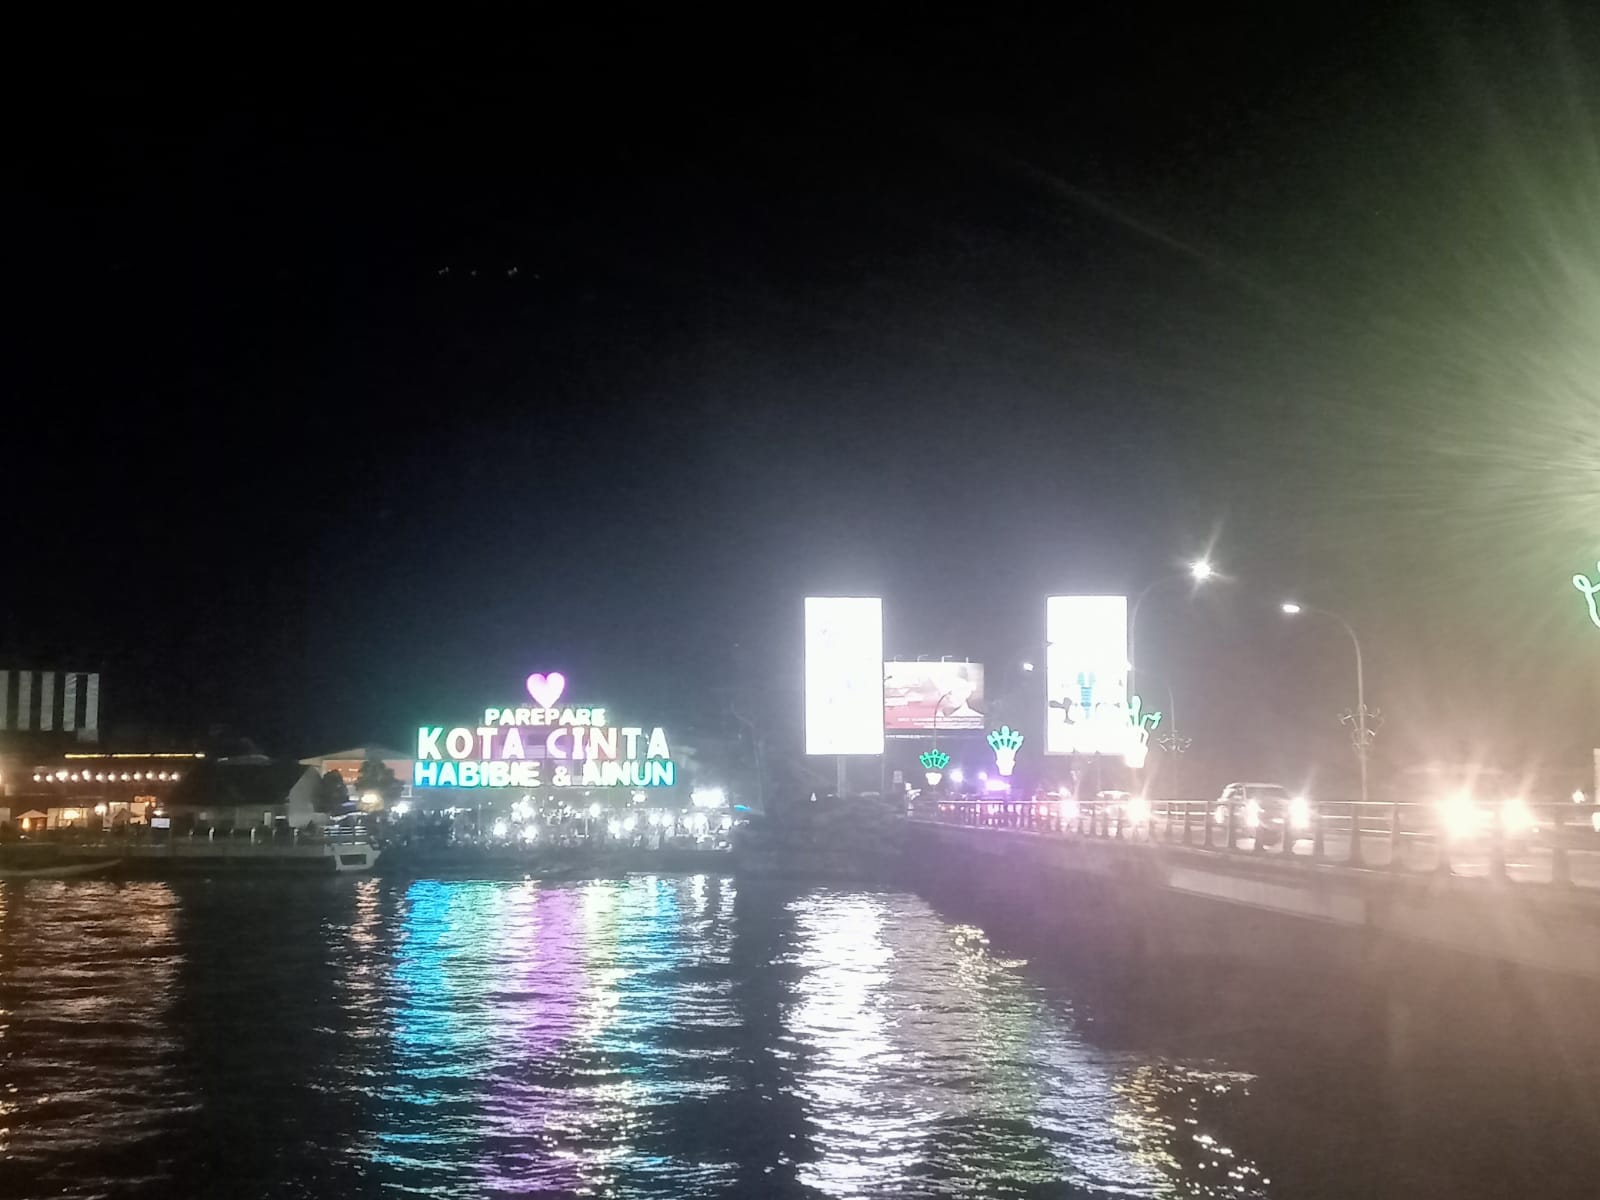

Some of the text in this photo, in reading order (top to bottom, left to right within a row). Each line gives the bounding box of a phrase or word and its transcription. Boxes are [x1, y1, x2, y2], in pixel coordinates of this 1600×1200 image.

[484, 708, 606, 726] PAREPARE
[417, 727, 671, 760] KOTA CINTA
[414, 761, 675, 786] HABIBIE & AINUN
